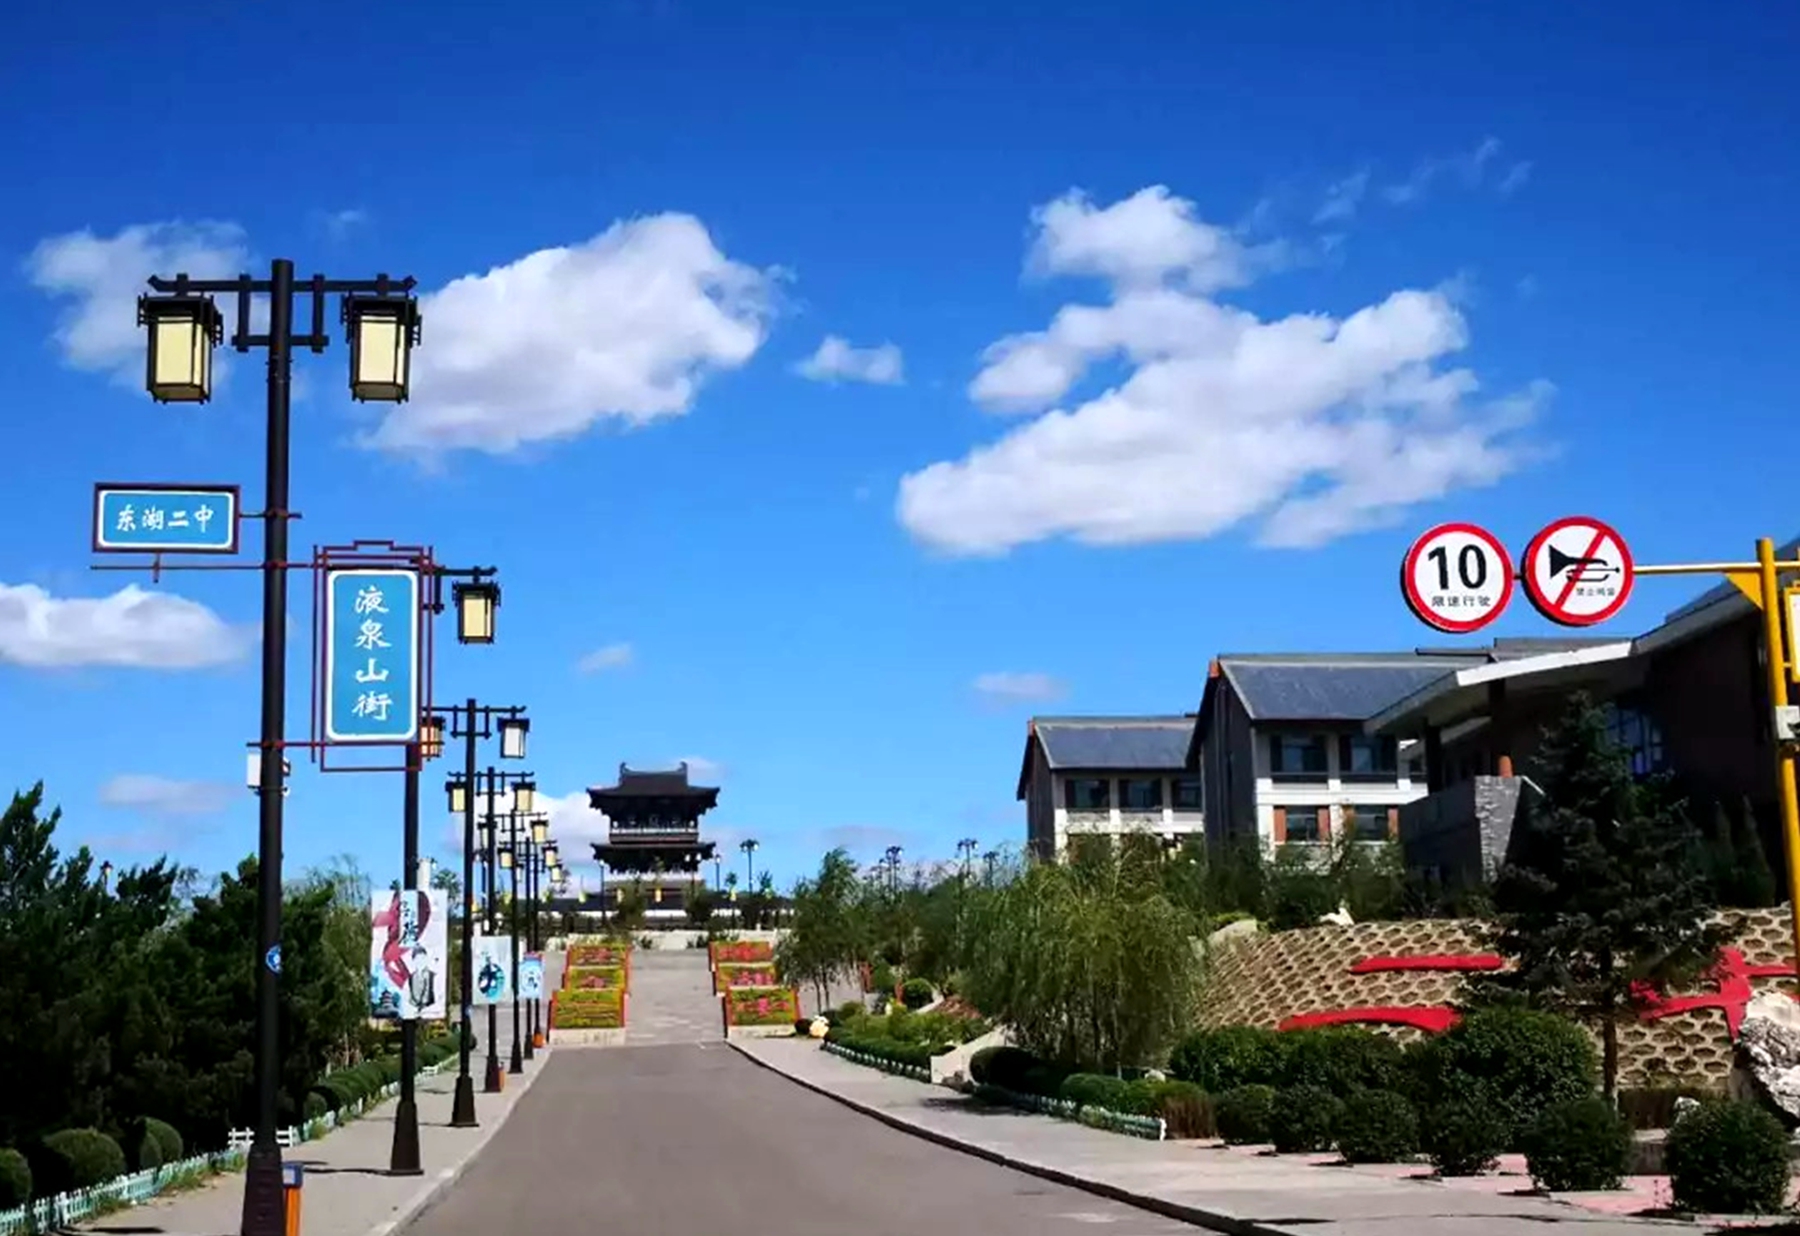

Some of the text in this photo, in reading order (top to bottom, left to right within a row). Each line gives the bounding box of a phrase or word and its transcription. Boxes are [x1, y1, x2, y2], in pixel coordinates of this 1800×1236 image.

[116, 504, 214, 533] 东湖二中
[1428, 544, 1487, 590] 10
[1432, 595, 1491, 607] 限速行驶
[352, 585, 393, 721] 液泉山街
